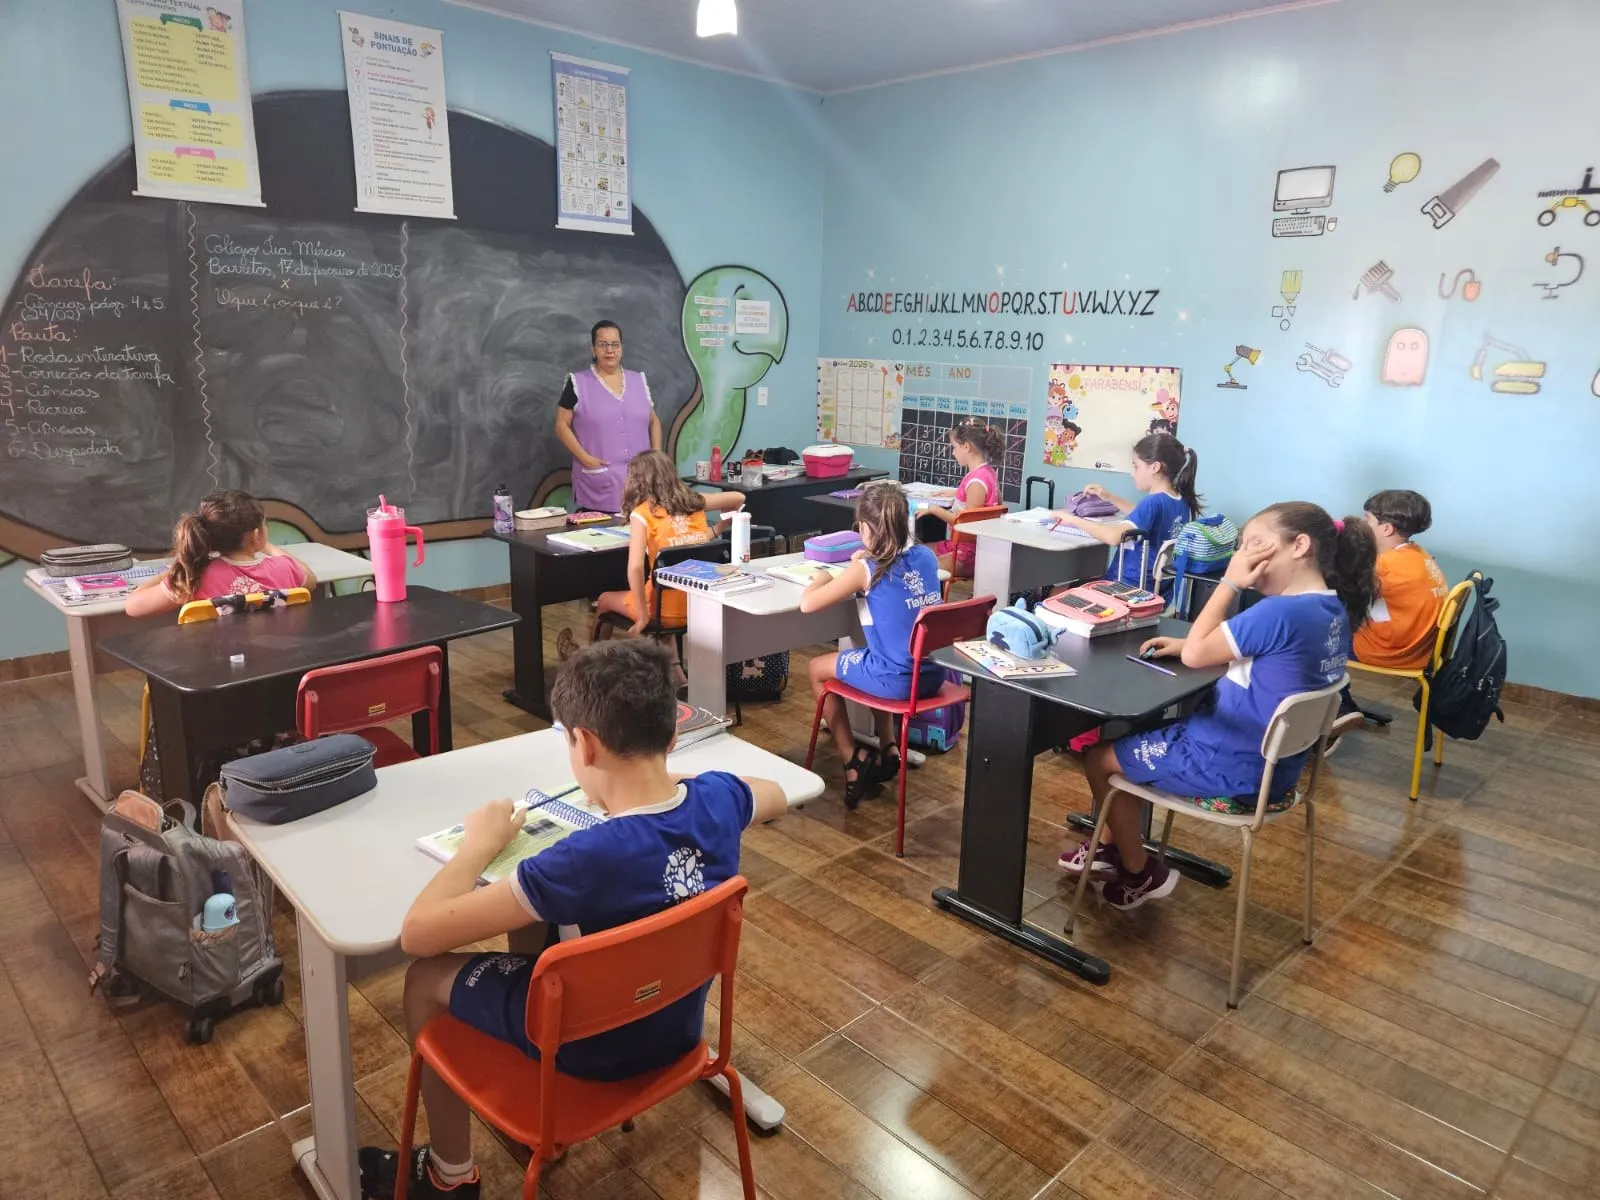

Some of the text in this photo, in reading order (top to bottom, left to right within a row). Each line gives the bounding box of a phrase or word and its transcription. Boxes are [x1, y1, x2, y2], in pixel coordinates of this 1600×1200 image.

[374, 31, 413, 46] SINAIS DE
[370, 40, 418, 57] PONTUAÇÃO
[205, 233, 259, 266] Colégio
[292, 240, 346, 257] Mércia
[278, 257, 293, 275] 17
[370, 262, 402, 279] 2025
[131, 295, 140, 309] 4
[20, 307, 81, 321] (24/02)
[905, 365, 931, 378] MÊS
[948, 367, 972, 379] ANO
[918, 442, 931, 454] 10
[918, 458, 929, 470] 17
[935, 460, 947, 472] 18
